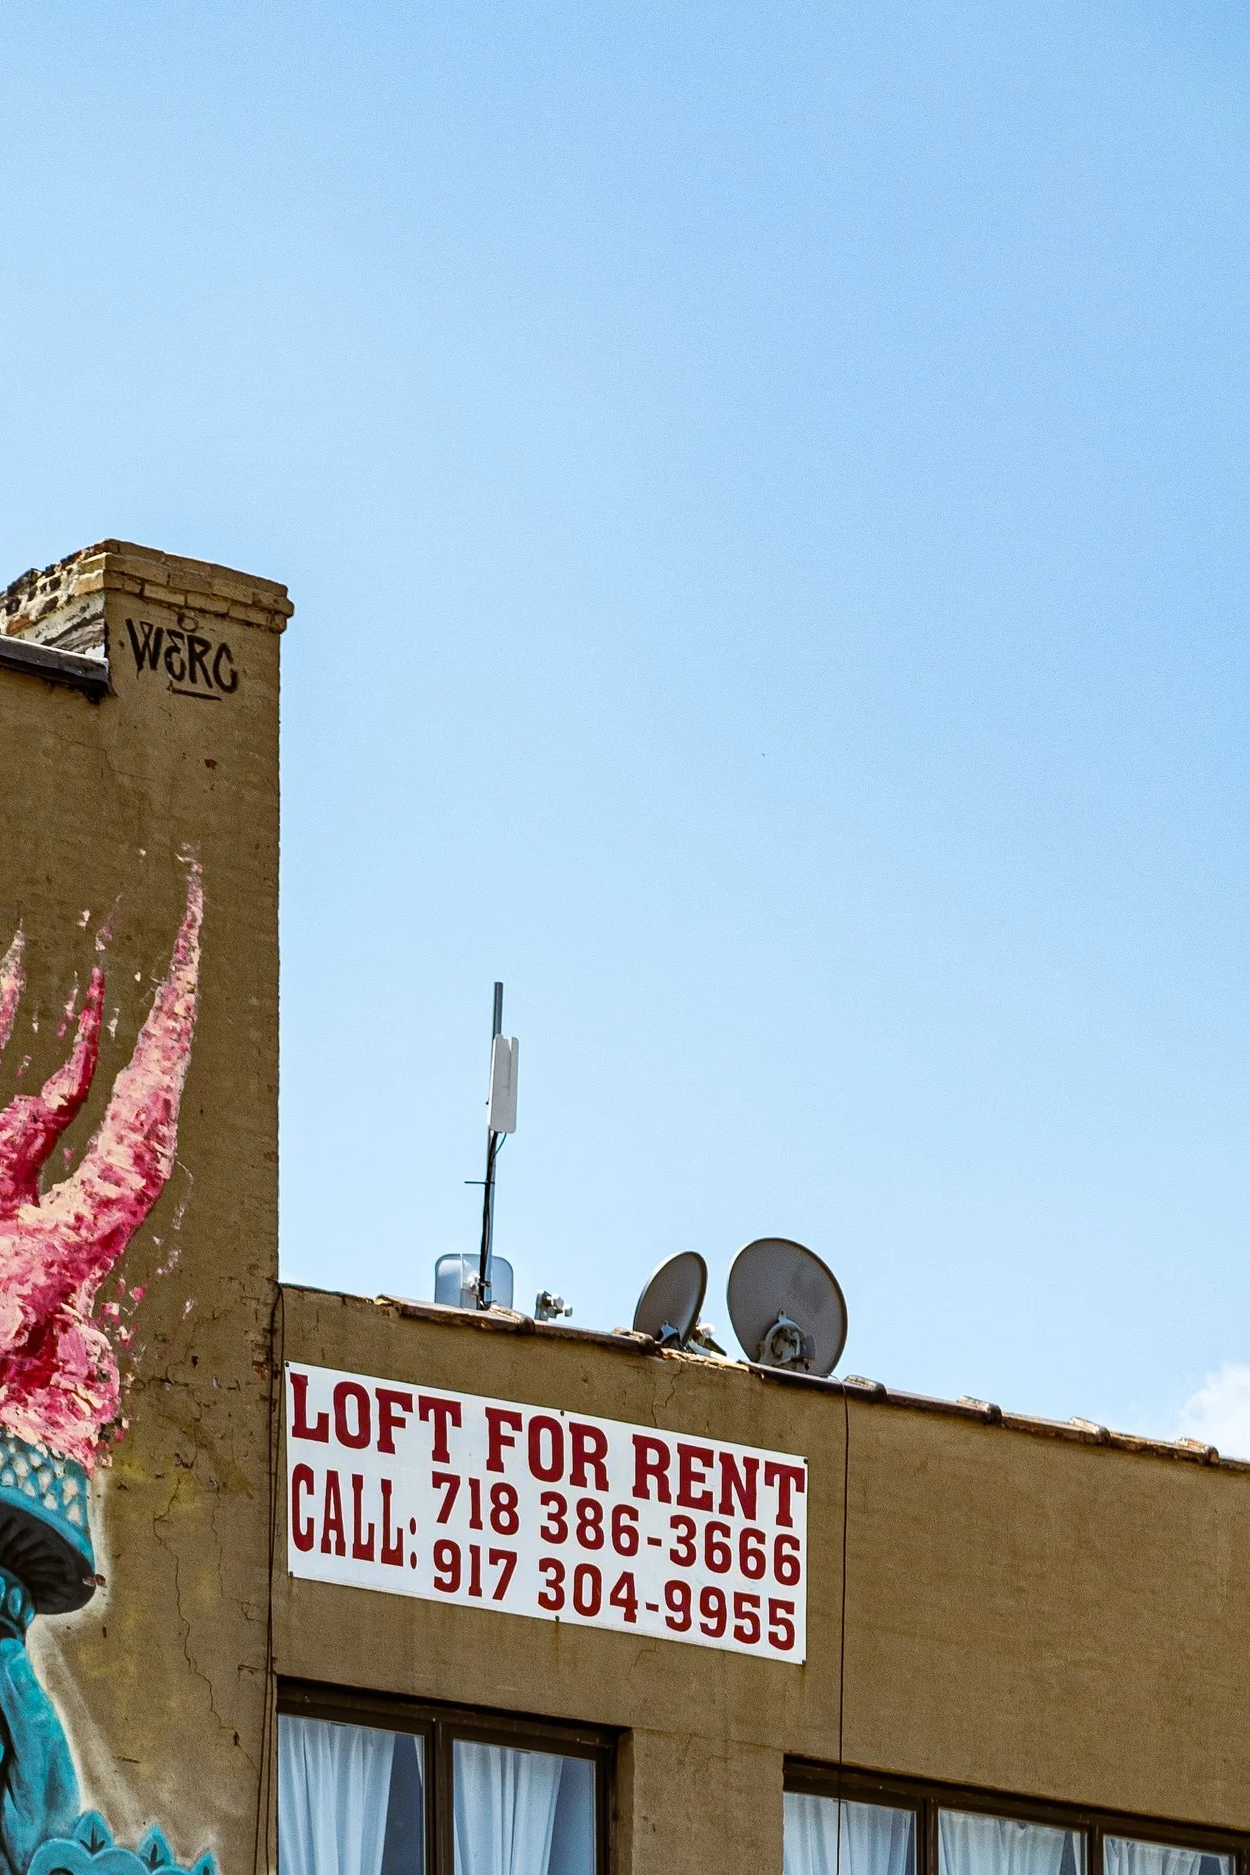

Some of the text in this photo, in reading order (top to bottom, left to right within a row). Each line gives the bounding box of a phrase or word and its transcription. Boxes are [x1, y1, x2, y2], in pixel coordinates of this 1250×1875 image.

[289, 1372, 806, 1529] LOFT FOR RENT
[291, 1463, 802, 1588] CALL: 718 386-3666
[433, 1539, 797, 1652] 917 304-9955
